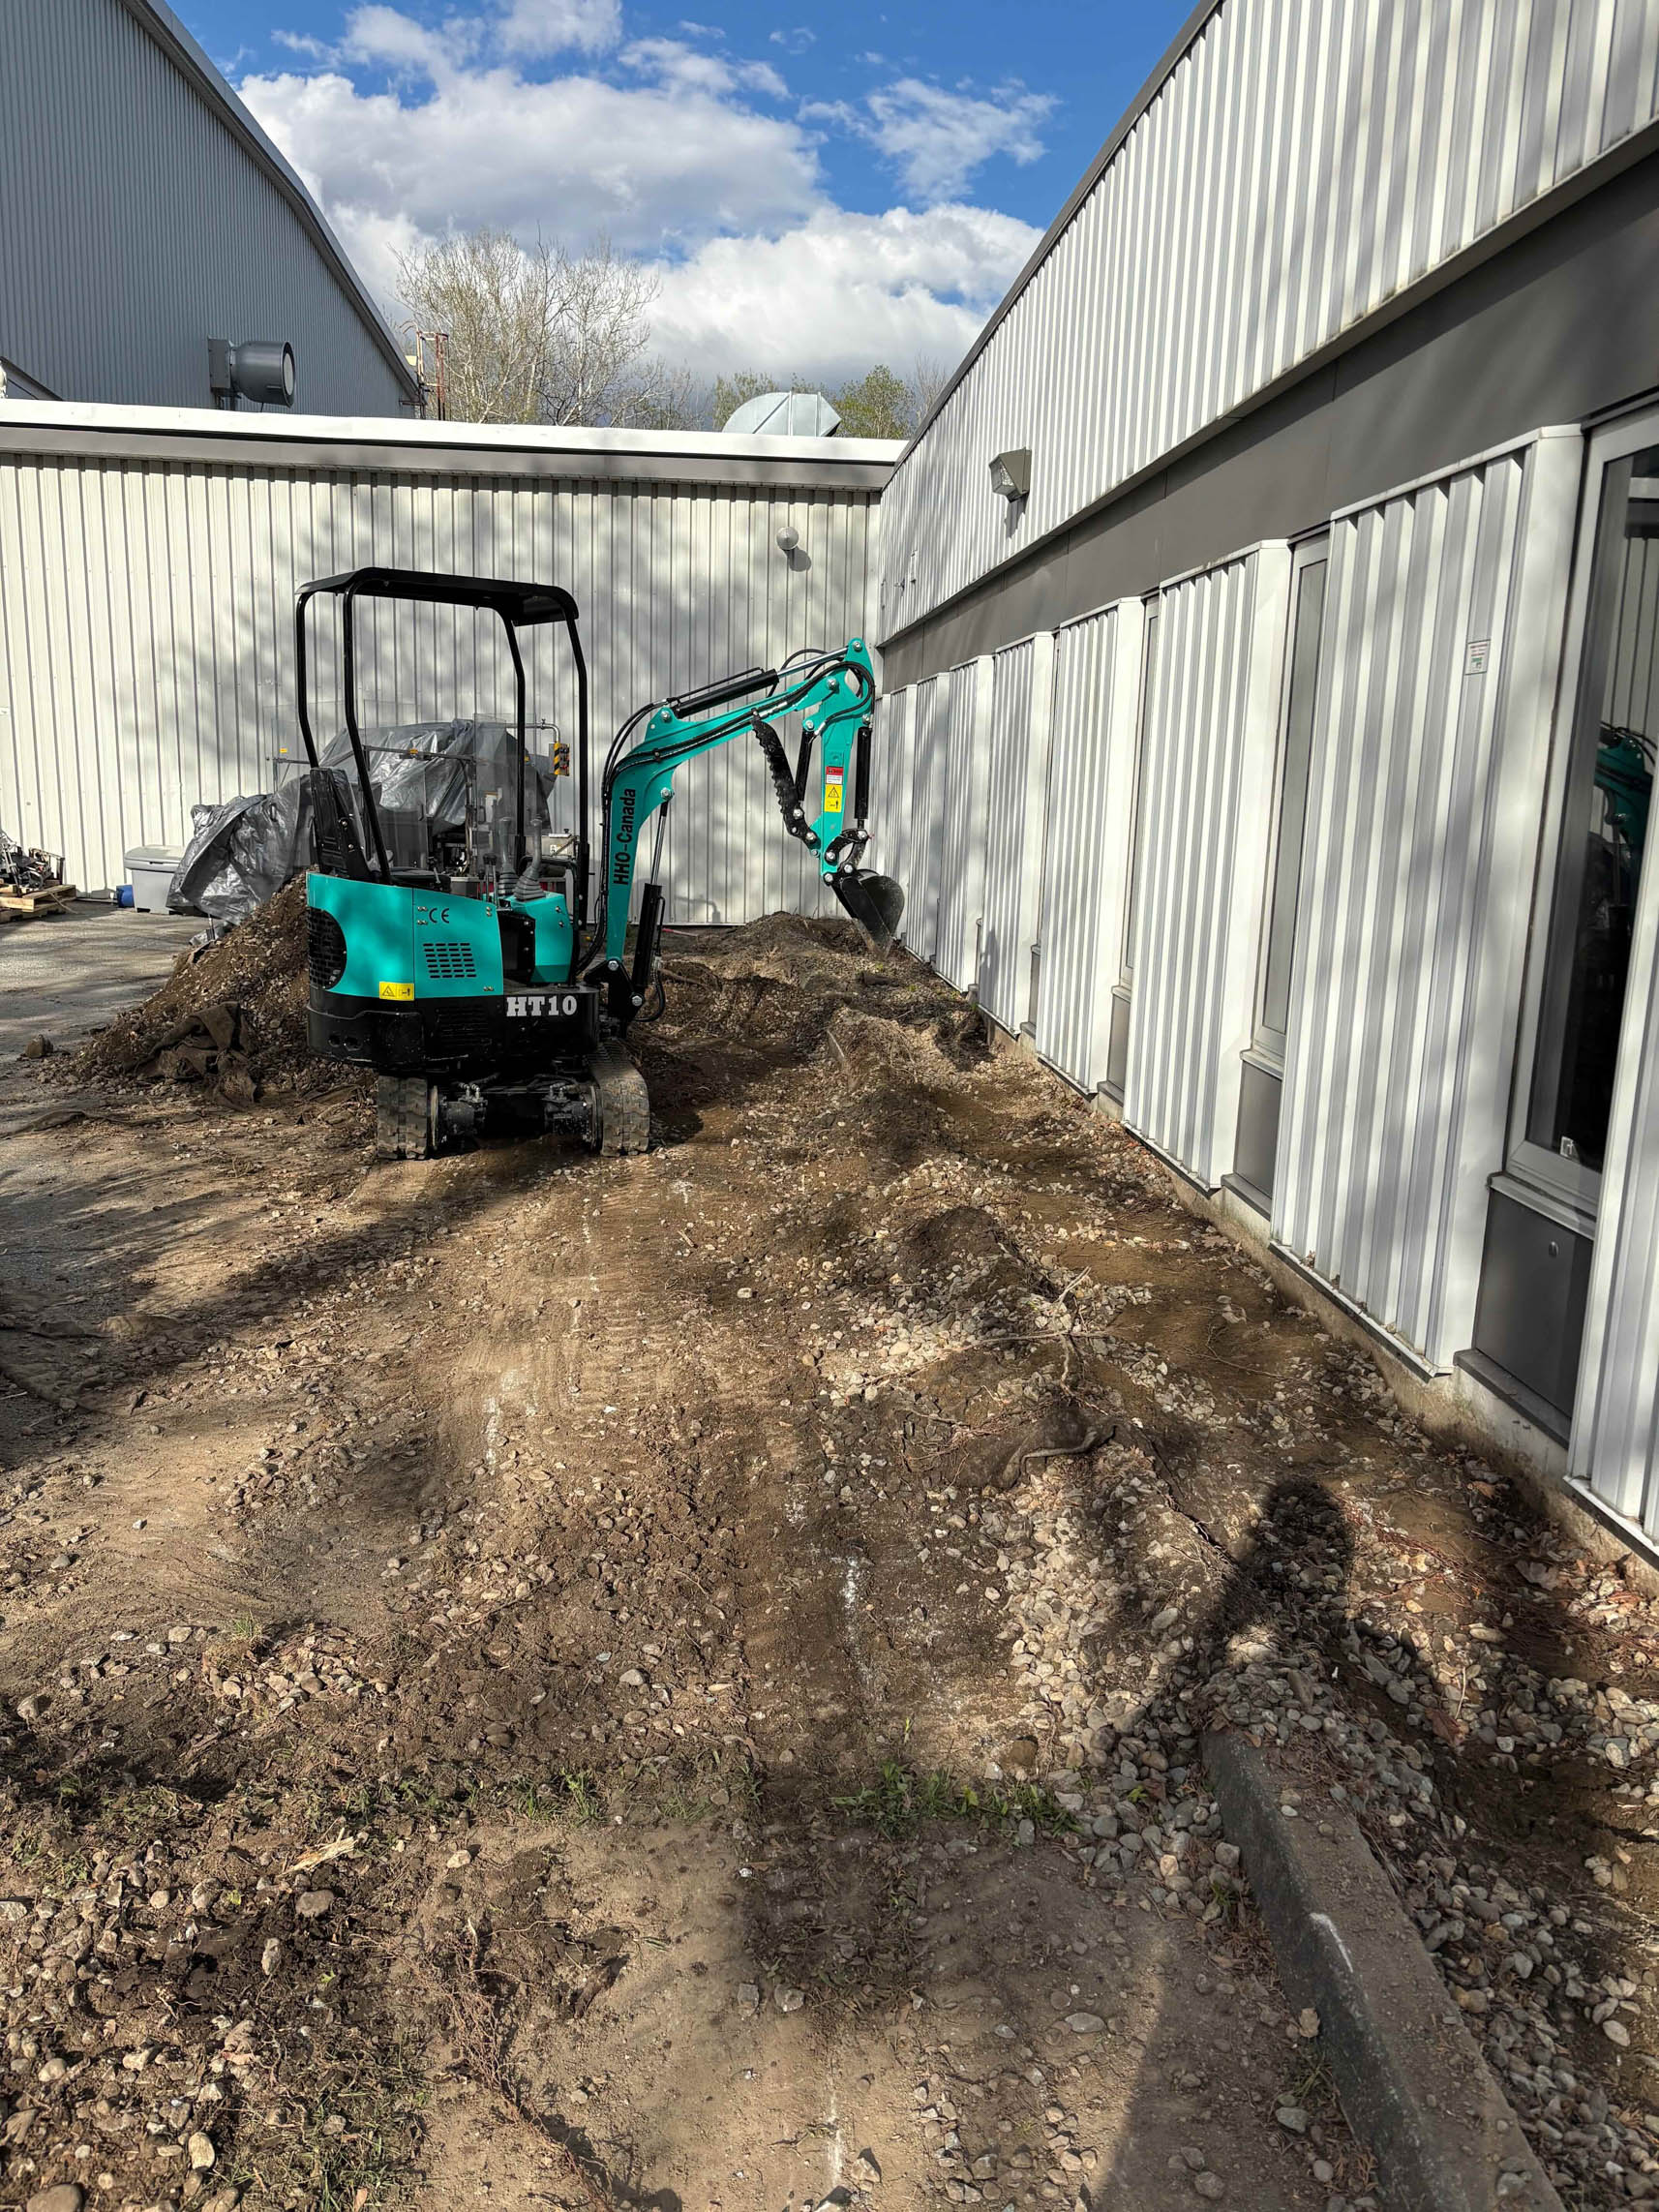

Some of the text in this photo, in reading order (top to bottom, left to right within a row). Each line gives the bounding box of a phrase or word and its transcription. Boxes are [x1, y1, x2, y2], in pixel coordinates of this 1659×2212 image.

[613, 788, 636, 885] HHO-Canada
[429, 907, 450, 924] CE
[506, 995, 578, 1016] HT10
